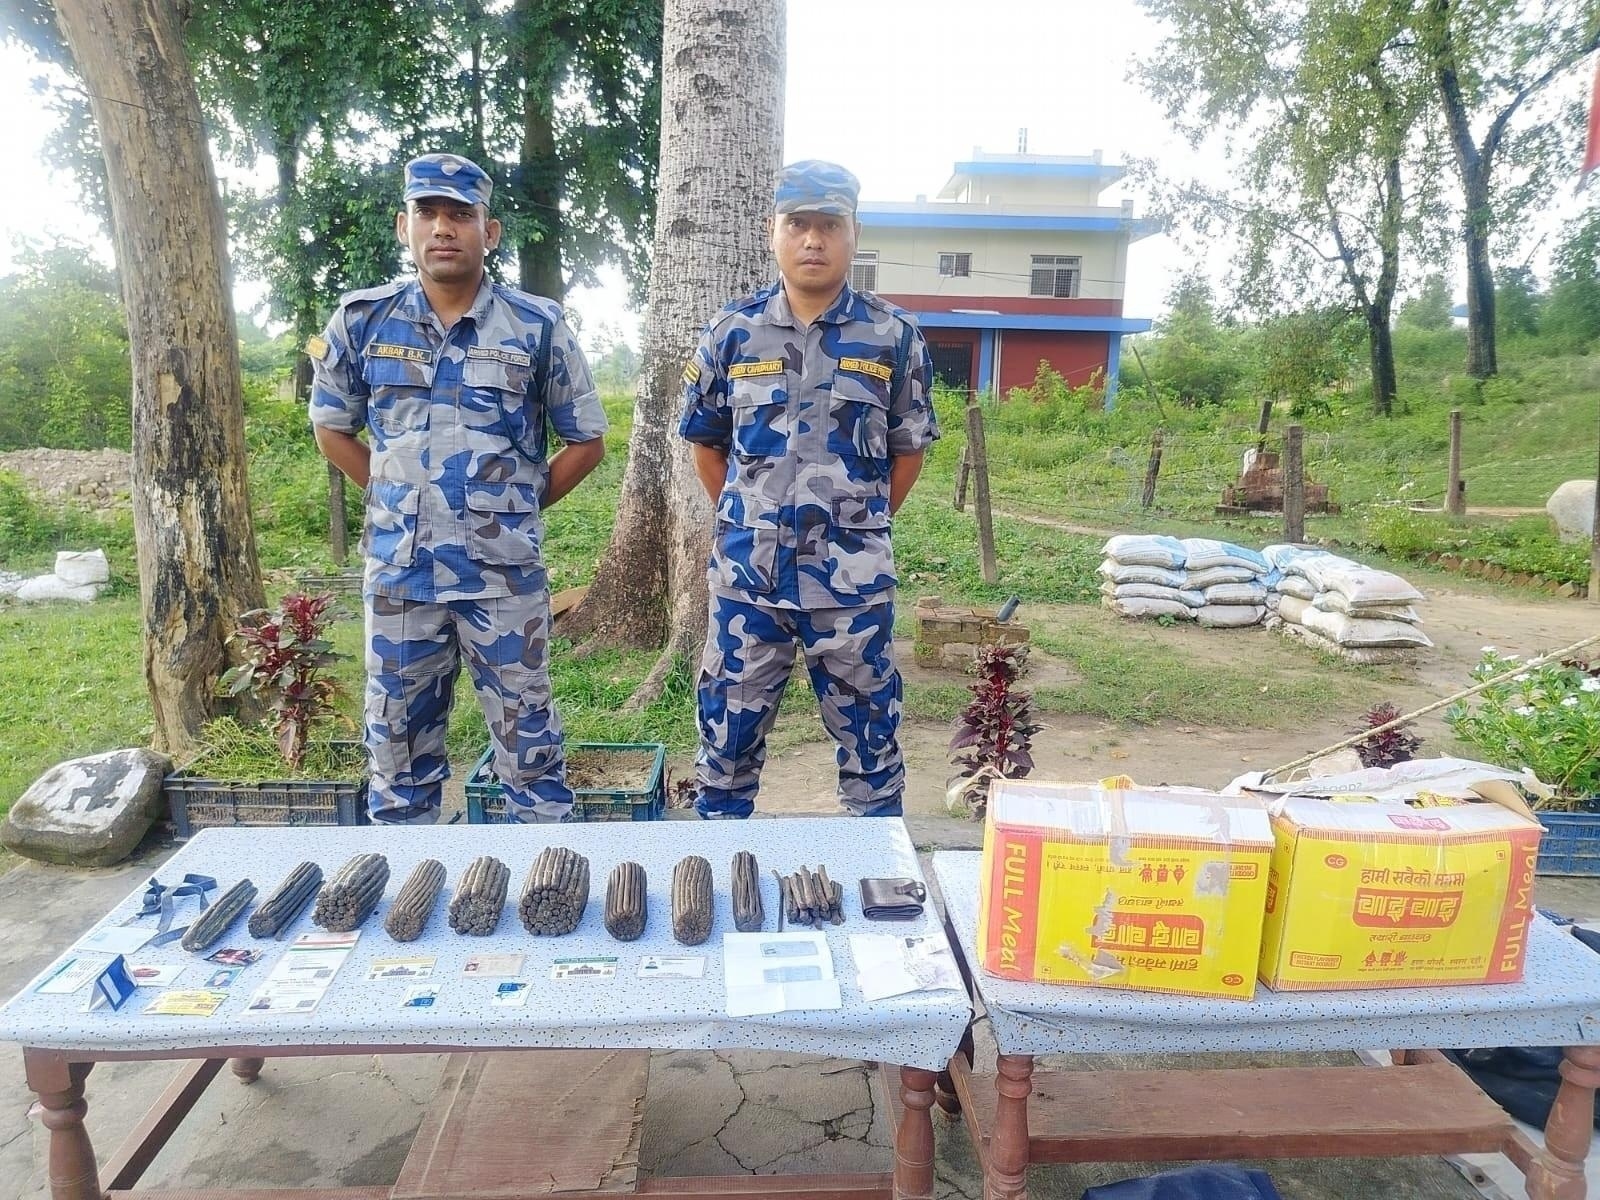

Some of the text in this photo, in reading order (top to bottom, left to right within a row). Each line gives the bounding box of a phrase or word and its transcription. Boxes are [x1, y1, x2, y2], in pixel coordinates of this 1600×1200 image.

[377, 346, 426, 360] AKBAR B.K.
[489, 349, 511, 361] POLICE
[1327, 856, 1346, 867] CG
[1361, 868, 1390, 885] हामी
[999, 841, 1027, 971] FULL Meal
[1499, 845, 1538, 972] FULL Meal
[1168, 958, 1198, 972] हामी
